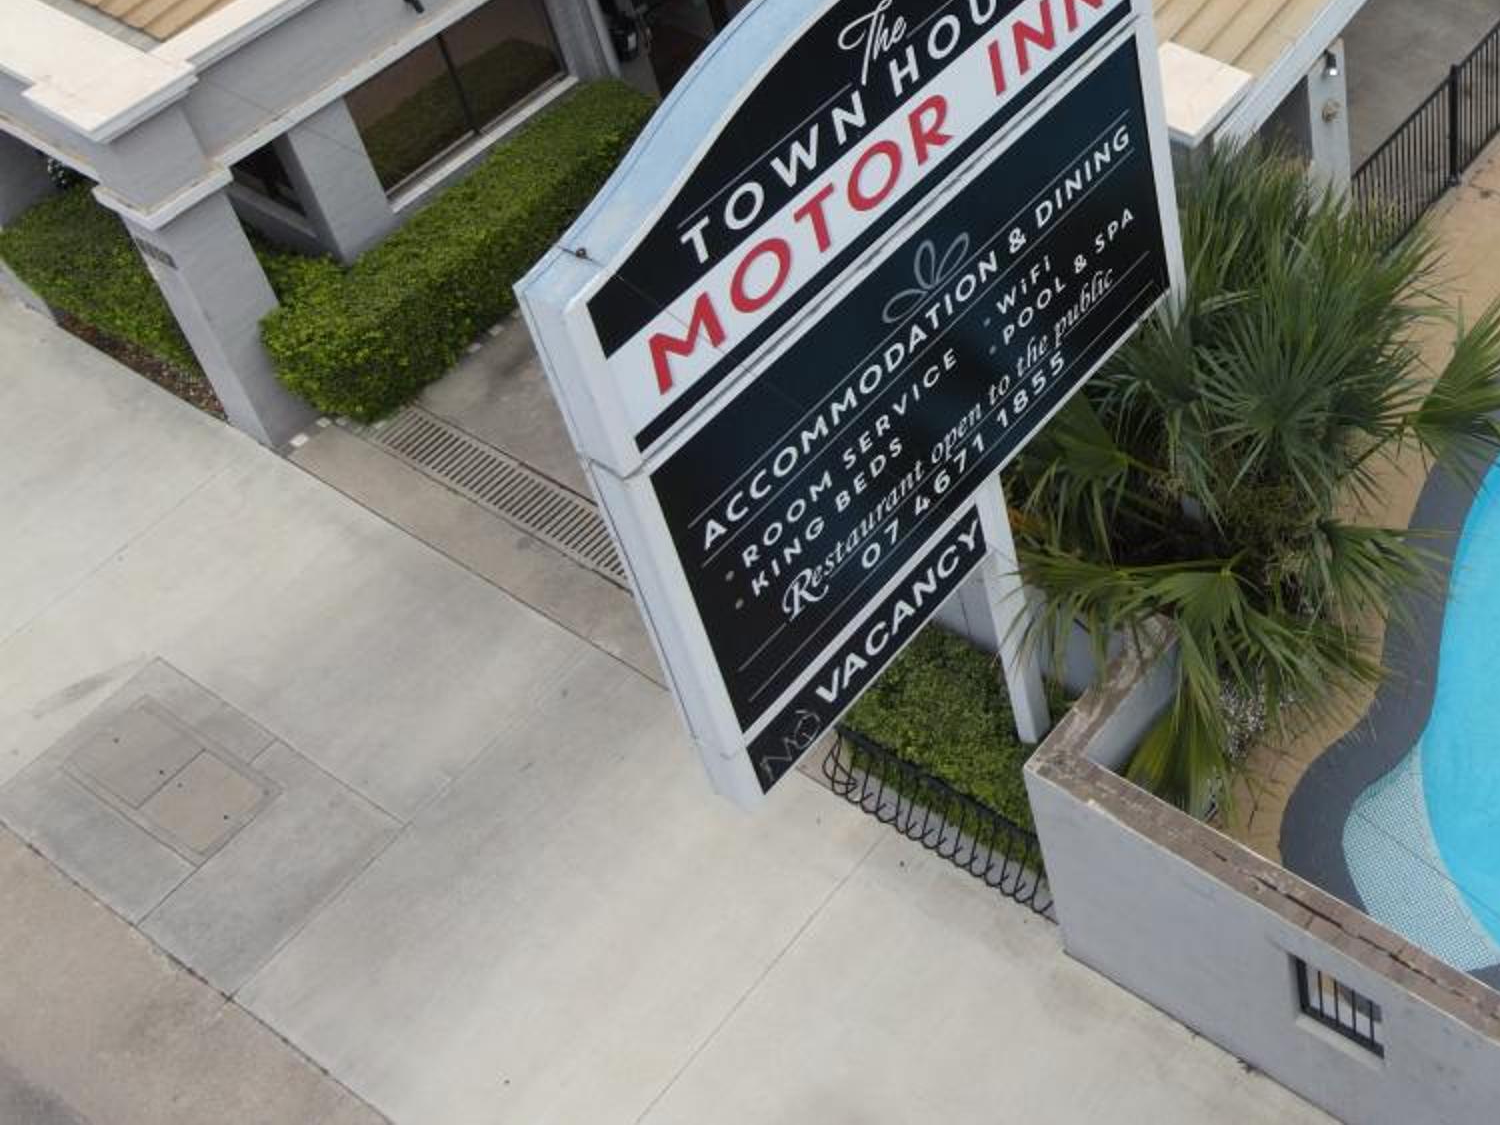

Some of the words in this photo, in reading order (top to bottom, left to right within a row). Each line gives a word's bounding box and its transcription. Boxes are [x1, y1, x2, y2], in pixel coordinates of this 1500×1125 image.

[646, 93, 955, 396] MOTOR
[680, 89, 867, 265] TOWN
[1002, 276, 1066, 345] POOL
[1073, 253, 1088, 274] &
[1094, 207, 1135, 254] SPA
[704, 249, 998, 550] ACCOMMODATION
[1008, 227, 1027, 254] &
[1034, 125, 1130, 229] DINING
[781, 459, 925, 623] Restaurant
[930, 402, 982, 464] open
[987, 374, 1010, 406] to
[1015, 334, 1049, 378] the
[1053, 267, 1114, 349] public
[741, 469, 832, 568] ROOM
[842, 347, 958, 470] SERVICE
[751, 516, 825, 597] KING
[834, 437, 903, 513] BEDS
[861, 518, 900, 570] 07
[914, 432, 985, 516] 4671
[996, 350, 1065, 428] 1855
[815, 518, 980, 704] VACANCY
